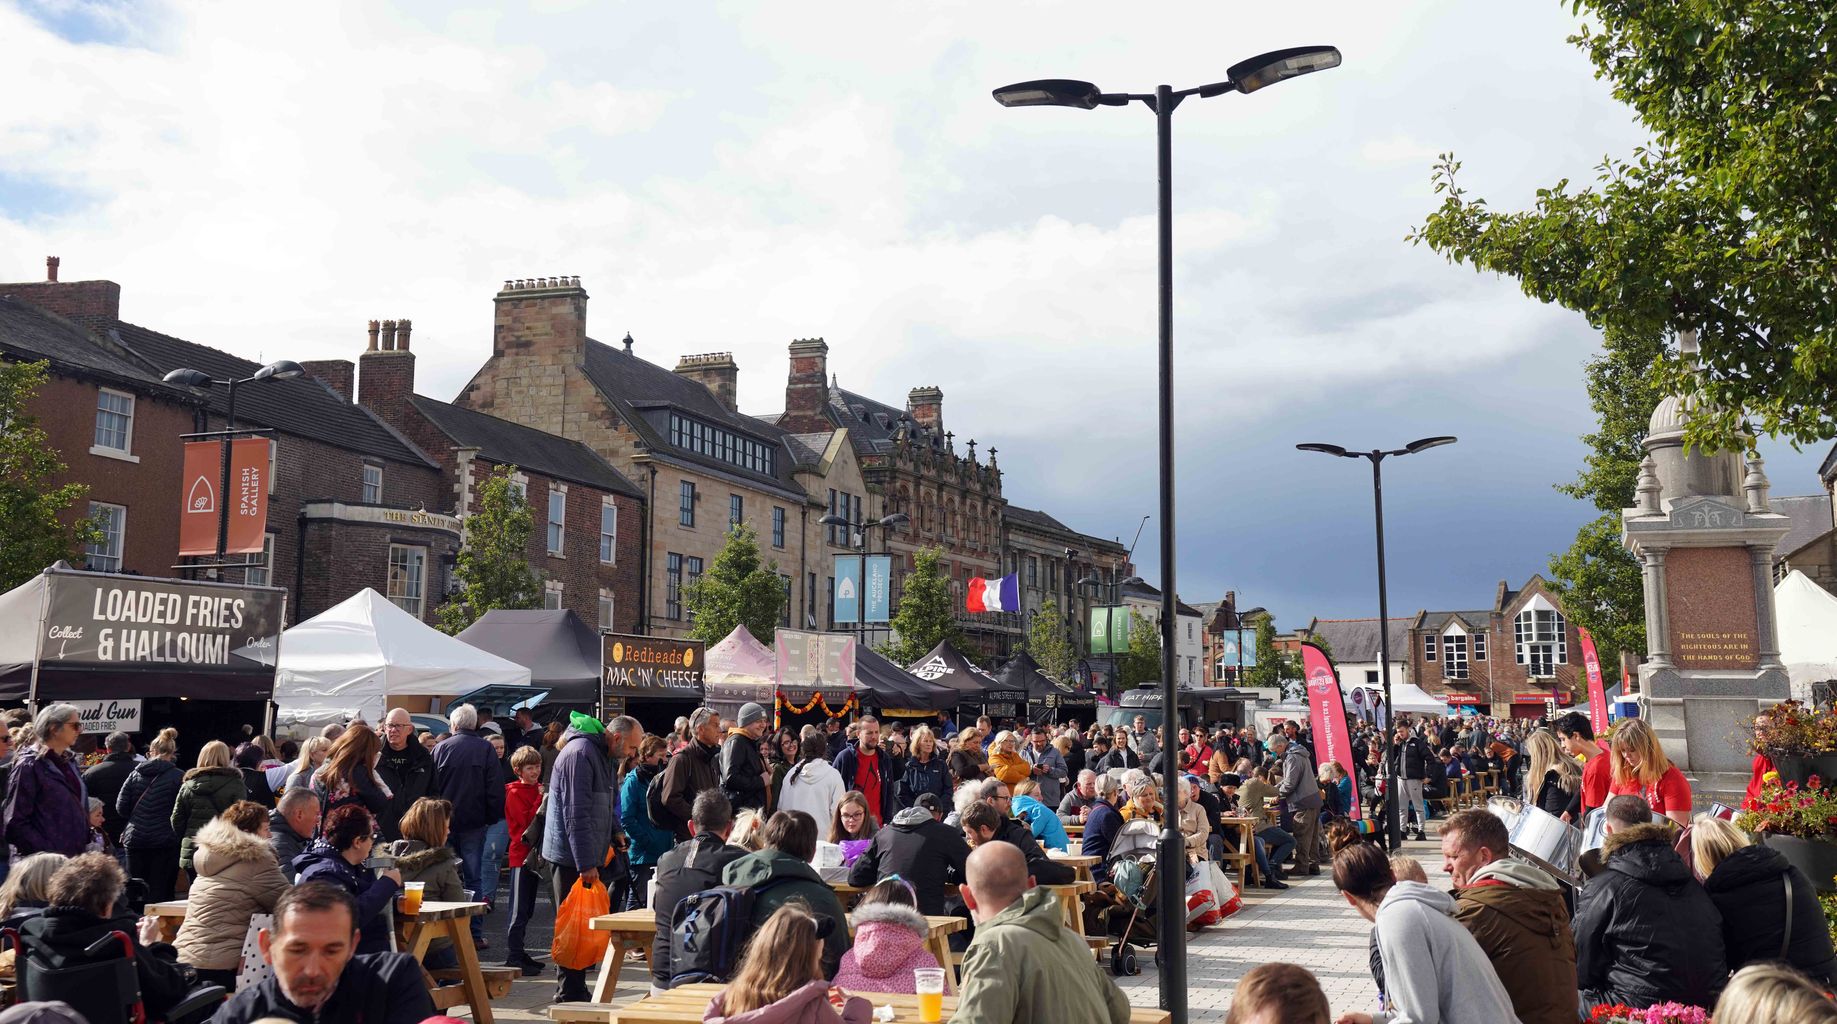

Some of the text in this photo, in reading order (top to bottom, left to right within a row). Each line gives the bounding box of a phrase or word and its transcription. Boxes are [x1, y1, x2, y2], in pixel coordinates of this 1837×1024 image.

[240, 468, 250, 515] SPANISH
[250, 467, 259, 516] GALLERY
[384, 511, 407, 521] THE
[411, 514, 446, 527] STANLEY
[93, 587, 245, 629] LOADED FRIES
[49, 625, 83, 640] Collect
[98, 628, 230, 665] & HALLOUMI
[246, 636, 271, 649] Order
[625, 645, 682, 664] Redheads
[606, 667, 636, 687] MAC
[656, 669, 699, 688] CHEESE
[910, 665, 955, 675] ALPINE
[1002, 691, 1015, 700] STREET
[1015, 691, 1025, 700] FOOD
[78, 701, 138, 721] ud Gun
[101, 721, 117, 731] FRIES
